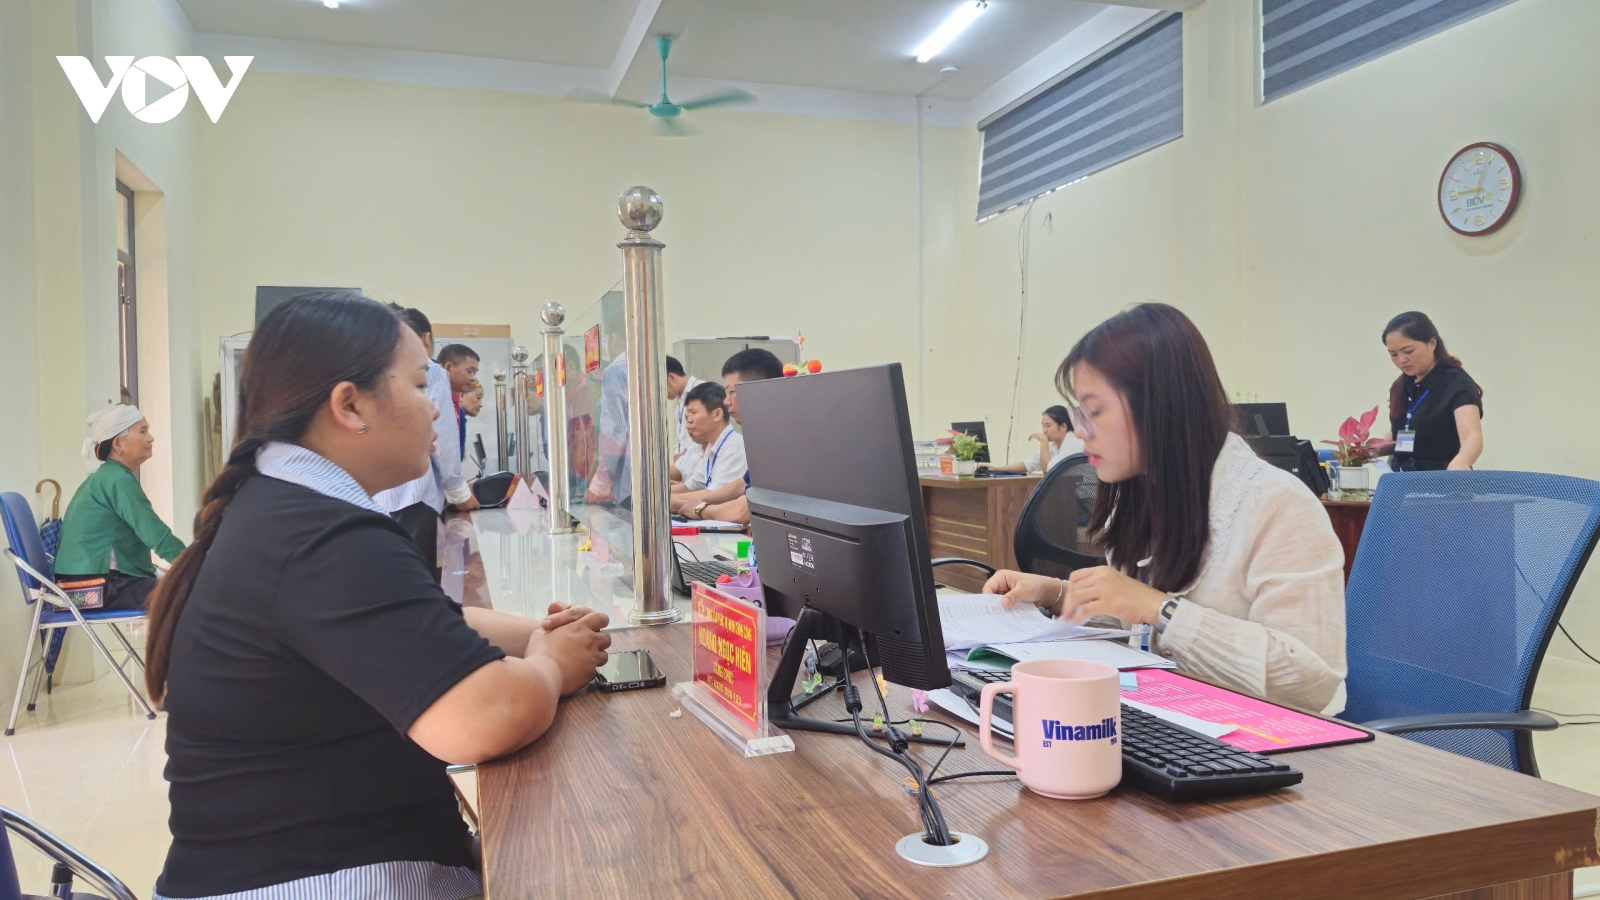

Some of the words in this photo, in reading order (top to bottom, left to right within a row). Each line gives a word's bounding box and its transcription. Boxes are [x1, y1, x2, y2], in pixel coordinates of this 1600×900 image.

[1466, 196, 1485, 208] BIDV
[1042, 717, 1117, 741] Vinamilk
[1043, 740, 1052, 748] EST
